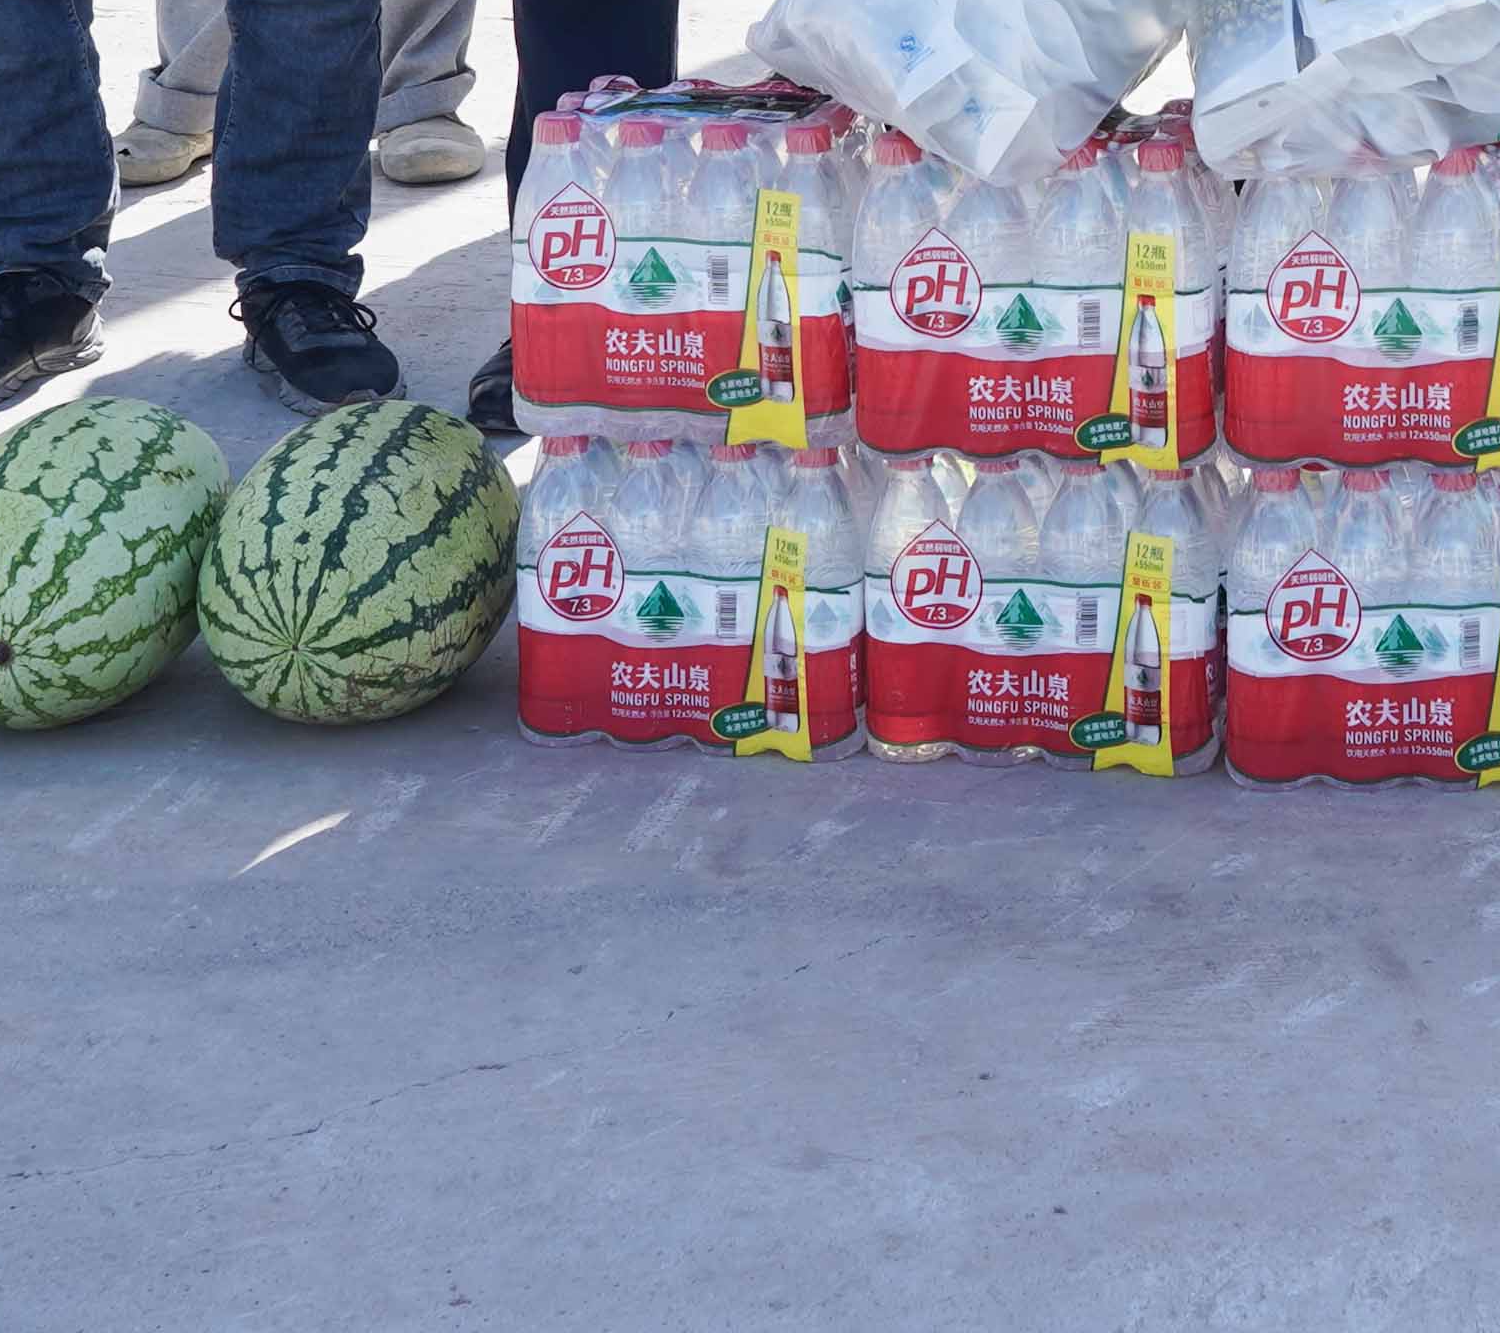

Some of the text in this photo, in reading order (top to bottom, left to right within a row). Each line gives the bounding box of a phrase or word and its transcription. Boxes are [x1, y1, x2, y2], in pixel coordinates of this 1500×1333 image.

[541, 219, 606, 269] pH
[561, 269, 584, 282] 7.3
[905, 264, 968, 313] pH
[1280, 269, 1346, 319] pH
[926, 313, 945, 327] 7.3
[1301, 320, 1323, 333] 7.3
[606, 328, 705, 358] 农夫山泉
[606, 358, 704, 374] NONGFU SPRING
[969, 375, 1074, 404] 农夫山泉
[1343, 383, 1451, 411] 农夫山泉
[970, 405, 1073, 421] NONGFU SPRING
[1343, 414, 1451, 429] NONGFU SPRING
[550, 549, 614, 597] pH
[904, 558, 970, 606] pH
[570, 599, 591, 613] 7.3
[926, 607, 947, 621] 7.3
[1280, 587, 1347, 639] pH
[1301, 638, 1323, 652] 7.3
[612, 663, 710, 691] 农夫山泉
[968, 670, 1069, 700] 农夫山泉
[612, 691, 709, 707] NONGFU SPRING
[968, 699, 1069, 717] NONGFU SPRING
[1346, 698, 1453, 726] 农夫山泉
[1347, 729, 1452, 743] NONGFU SPRING
